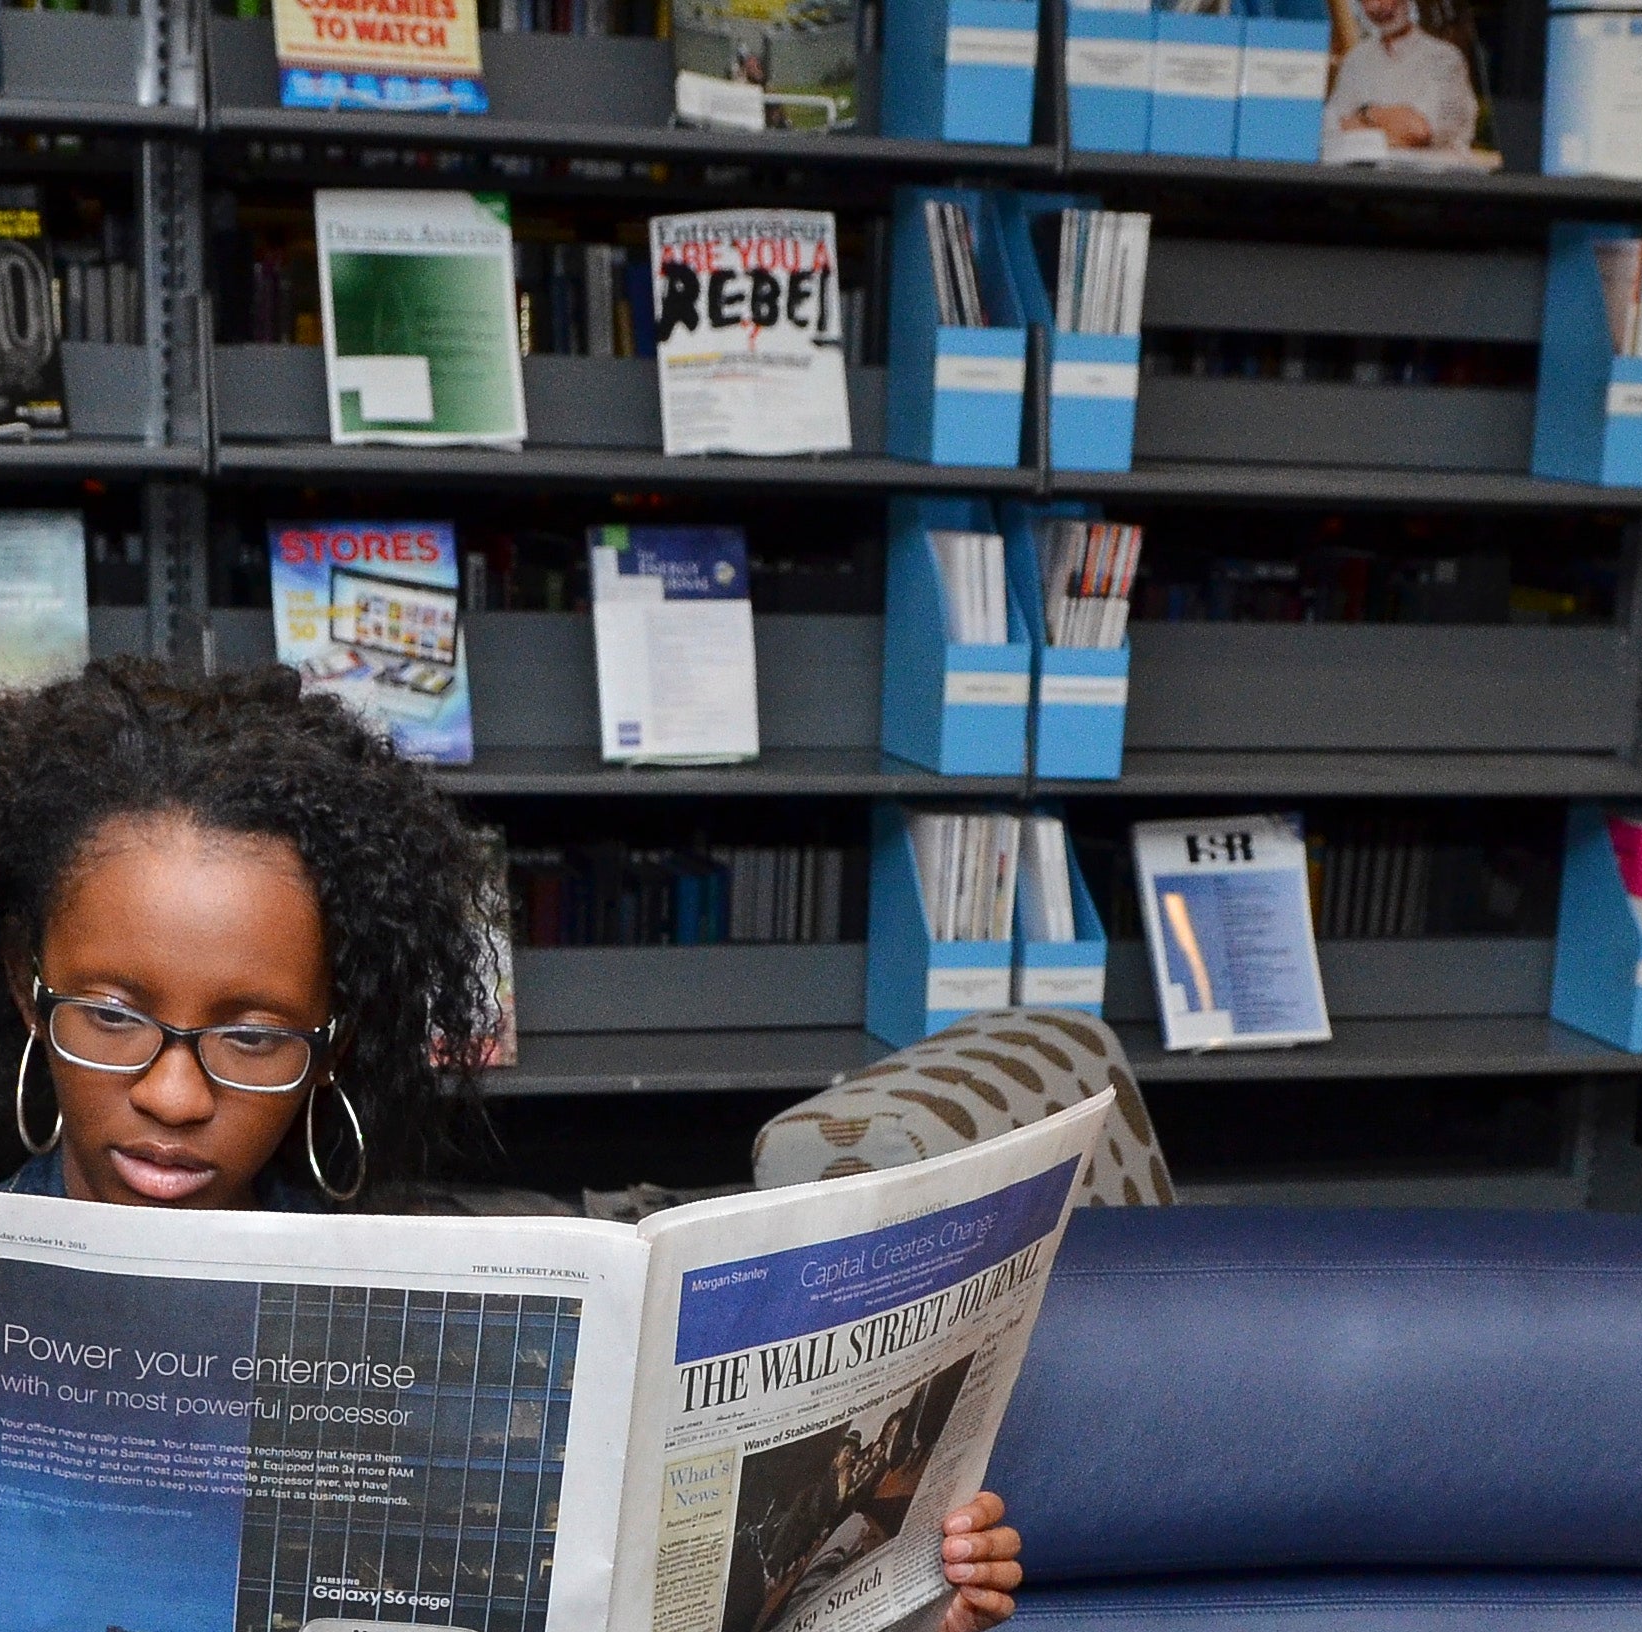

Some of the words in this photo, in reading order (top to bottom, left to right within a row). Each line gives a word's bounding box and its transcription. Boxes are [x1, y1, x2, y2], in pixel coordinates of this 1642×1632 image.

[312, 15, 347, 40] TO
[353, 18, 447, 48] WATCH
[660, 240, 721, 275] ARE
[732, 238, 800, 272] YOU
[813, 240, 831, 271] A
[653, 262, 843, 347] REBEL
[280, 529, 441, 565] STORES
[875, 1198, 950, 1230] ADVERTISEMENT
[18, 1235, 52, 1247] October
[68, 1241, 87, 1250] 2015
[801, 1250, 865, 1288] Capital
[872, 1232, 935, 1269] Creates
[938, 1209, 999, 1247] Change
[471, 1264, 489, 1273] THE
[491, 1266, 514, 1274] WALL
[516, 1267, 548, 1276] STREET
[691, 1272, 730, 1292] Morgan
[730, 1264, 769, 1285] Stanley
[679, 1352, 751, 1414] THE
[759, 1329, 840, 1396] WALL
[845, 1291, 951, 1370] STREET
[947, 1242, 1040, 1329] JOURNAL
[3, 1323, 122, 1370] Power
[135, 1349, 218, 1380] your
[231, 1353, 416, 1392] enterprise
[0, 1373, 49, 1398] with
[57, 1384, 98, 1404] our
[106, 1390, 167, 1412] most
[175, 1395, 281, 1417] powerful
[289, 1403, 413, 1427] processor
[0, 1417, 24, 1430] Your
[26, 1421, 56, 1435] office
[58, 1427, 87, 1440] never
[89, 1432, 119, 1445] really
[120, 1434, 159, 1447] closes.
[162, 1438, 186, 1449] Your
[189, 1441, 216, 1453] team
[219, 1443, 252, 1454] needs
[254, 1446, 314, 1460] technology
[316, 1449, 337, 1460] that
[339, 1450, 372, 1463] keeps
[373, 1452, 402, 1464] them
[743, 1435, 772, 1453] Wave
[773, 1431, 784, 1443] of
[785, 1417, 829, 1441] Stabbings
[830, 1410, 846, 1425] and
[846, 1394, 886, 1419] Shootings
[0, 1432, 59, 1449] productive.
[63, 1440, 86, 1454] This
[87, 1445, 98, 1455] is
[100, 1446, 118, 1457] the
[120, 1448, 170, 1464] Samsung
[173, 1451, 209, 1467] Galaxy
[212, 1456, 228, 1467] S6
[230, 1458, 260, 1471] edge.
[263, 1460, 315, 1475] Equipped
[316, 1462, 340, 1475] with
[341, 1464, 356, 1475] 3x
[357, 1466, 385, 1477] more
[387, 1466, 415, 1479] RAM
[0, 1444, 25, 1456] than
[27, 1448, 44, 1460] the
[46, 1451, 83, 1467] iPhone
[99, 1460, 120, 1471] and
[122, 1463, 141, 1473] our
[143, 1464, 170, 1477] most
[173, 1466, 220, 1481] powerful
[222, 1470, 258, 1482] mobile
[260, 1474, 314, 1487] processor
[316, 1478, 342, 1489] ever,
[344, 1480, 360, 1489] we
[362, 1480, 389, 1491] have
[668, 1459, 732, 1489] What's
[0, 1458, 42, 1473] created
[43, 1465, 51, 1473] a
[52, 1467, 95, 1482] superior
[98, 1474, 143, 1486] platform
[145, 1478, 157, 1487] to
[159, 1480, 186, 1492] keep
[188, 1483, 209, 1495] you
[211, 1484, 252, 1497] working
[255, 1488, 268, 1498] as
[271, 1488, 292, 1499] fast
[293, 1491, 307, 1500] as
[309, 1490, 356, 1502] business
[358, 1493, 412, 1506] demands.
[673, 1487, 721, 1511] News
[312, 1585, 382, 1607] Galaxy
[383, 1589, 406, 1605] S6
[408, 1594, 451, 1611] edge
[315, 1576, 360, 1586] SAMSUNG
[824, 1565, 884, 1616] Stretch
